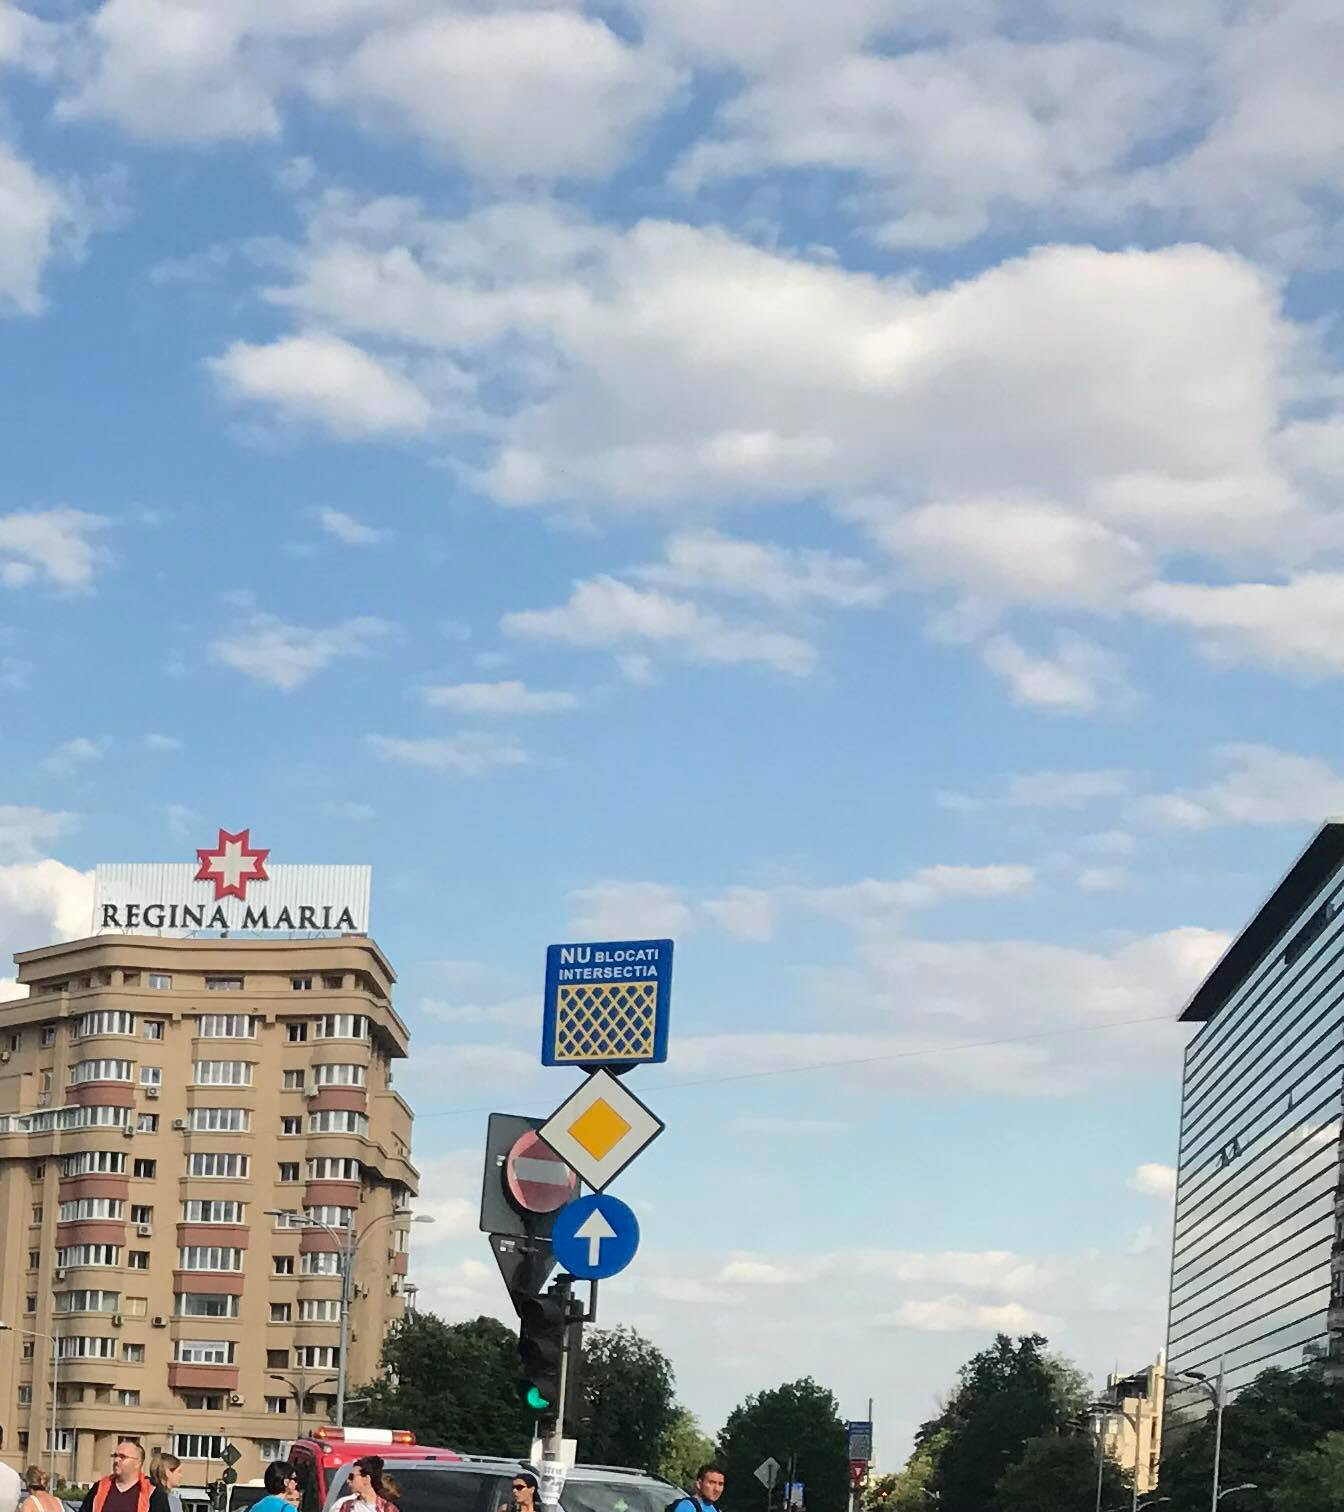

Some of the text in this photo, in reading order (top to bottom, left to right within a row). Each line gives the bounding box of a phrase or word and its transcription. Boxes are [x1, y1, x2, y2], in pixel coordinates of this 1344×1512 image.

[100, 903, 358, 930] REGINA MARIA
[560, 946, 659, 964] NU BLOCATI
[559, 965, 658, 981] INTERSECTIA
